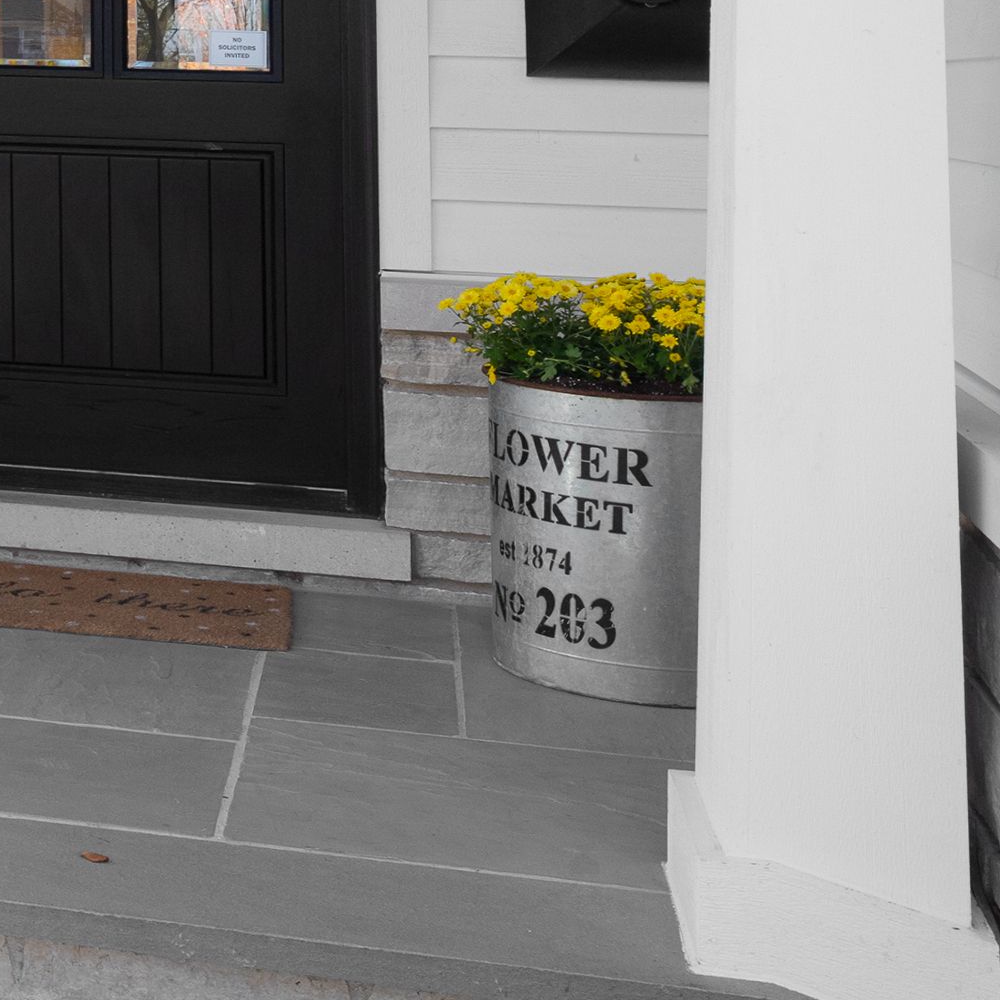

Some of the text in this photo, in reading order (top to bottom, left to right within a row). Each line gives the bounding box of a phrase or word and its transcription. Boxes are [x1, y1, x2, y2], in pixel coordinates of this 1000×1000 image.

[500, 540, 572, 575] est 1874
[535, 586, 617, 650] 203
